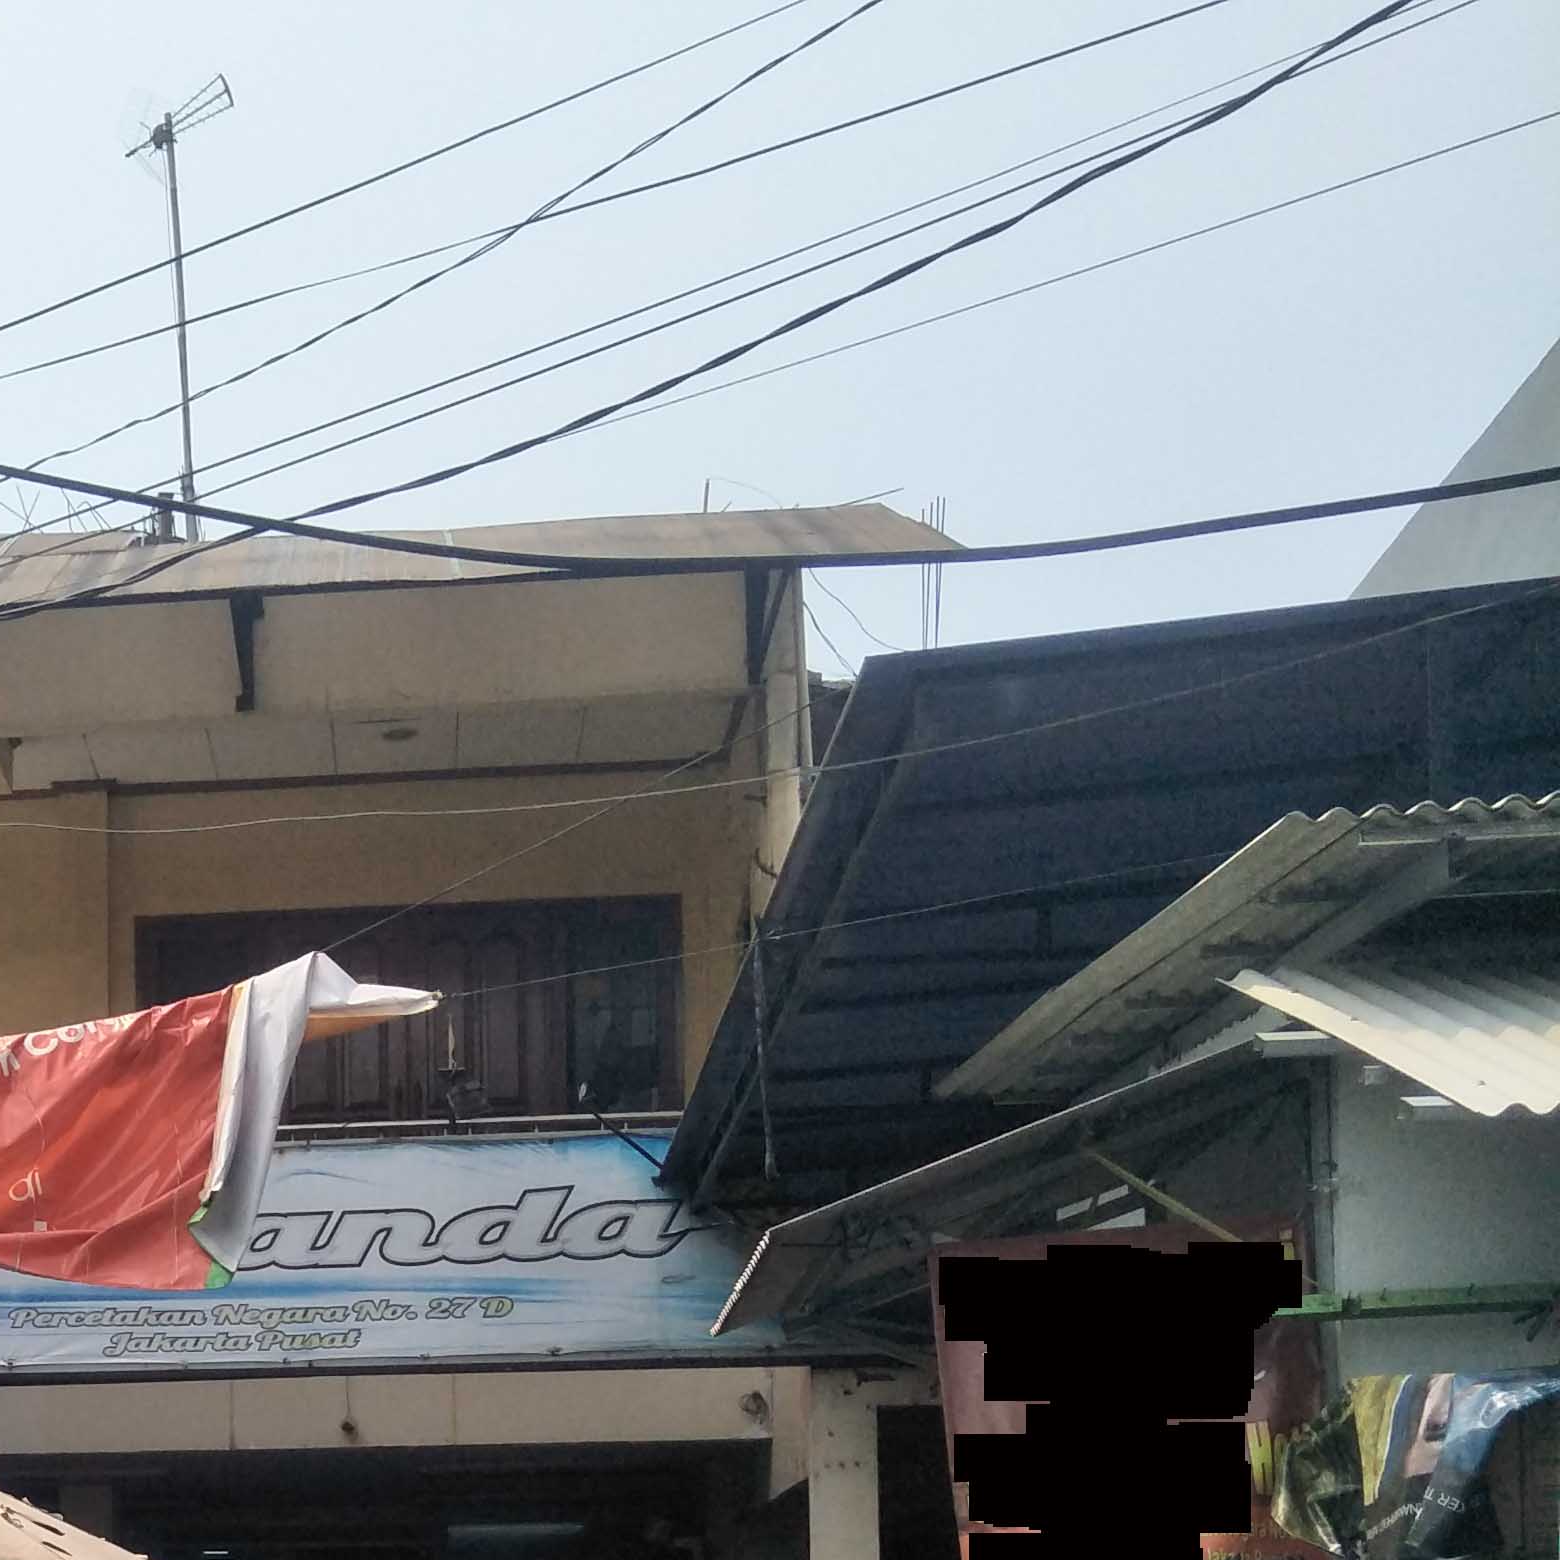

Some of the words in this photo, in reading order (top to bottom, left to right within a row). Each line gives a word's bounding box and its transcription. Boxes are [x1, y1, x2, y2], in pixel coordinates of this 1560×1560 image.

[7, 1305, 208, 1330] Percetakan
[212, 1303, 349, 1331] Negara
[353, 1298, 419, 1323] No.
[424, 1296, 470, 1320] 27
[478, 1295, 514, 1319] D
[102, 1329, 253, 1357] Jakarta
[255, 1327, 362, 1353] Pusat
